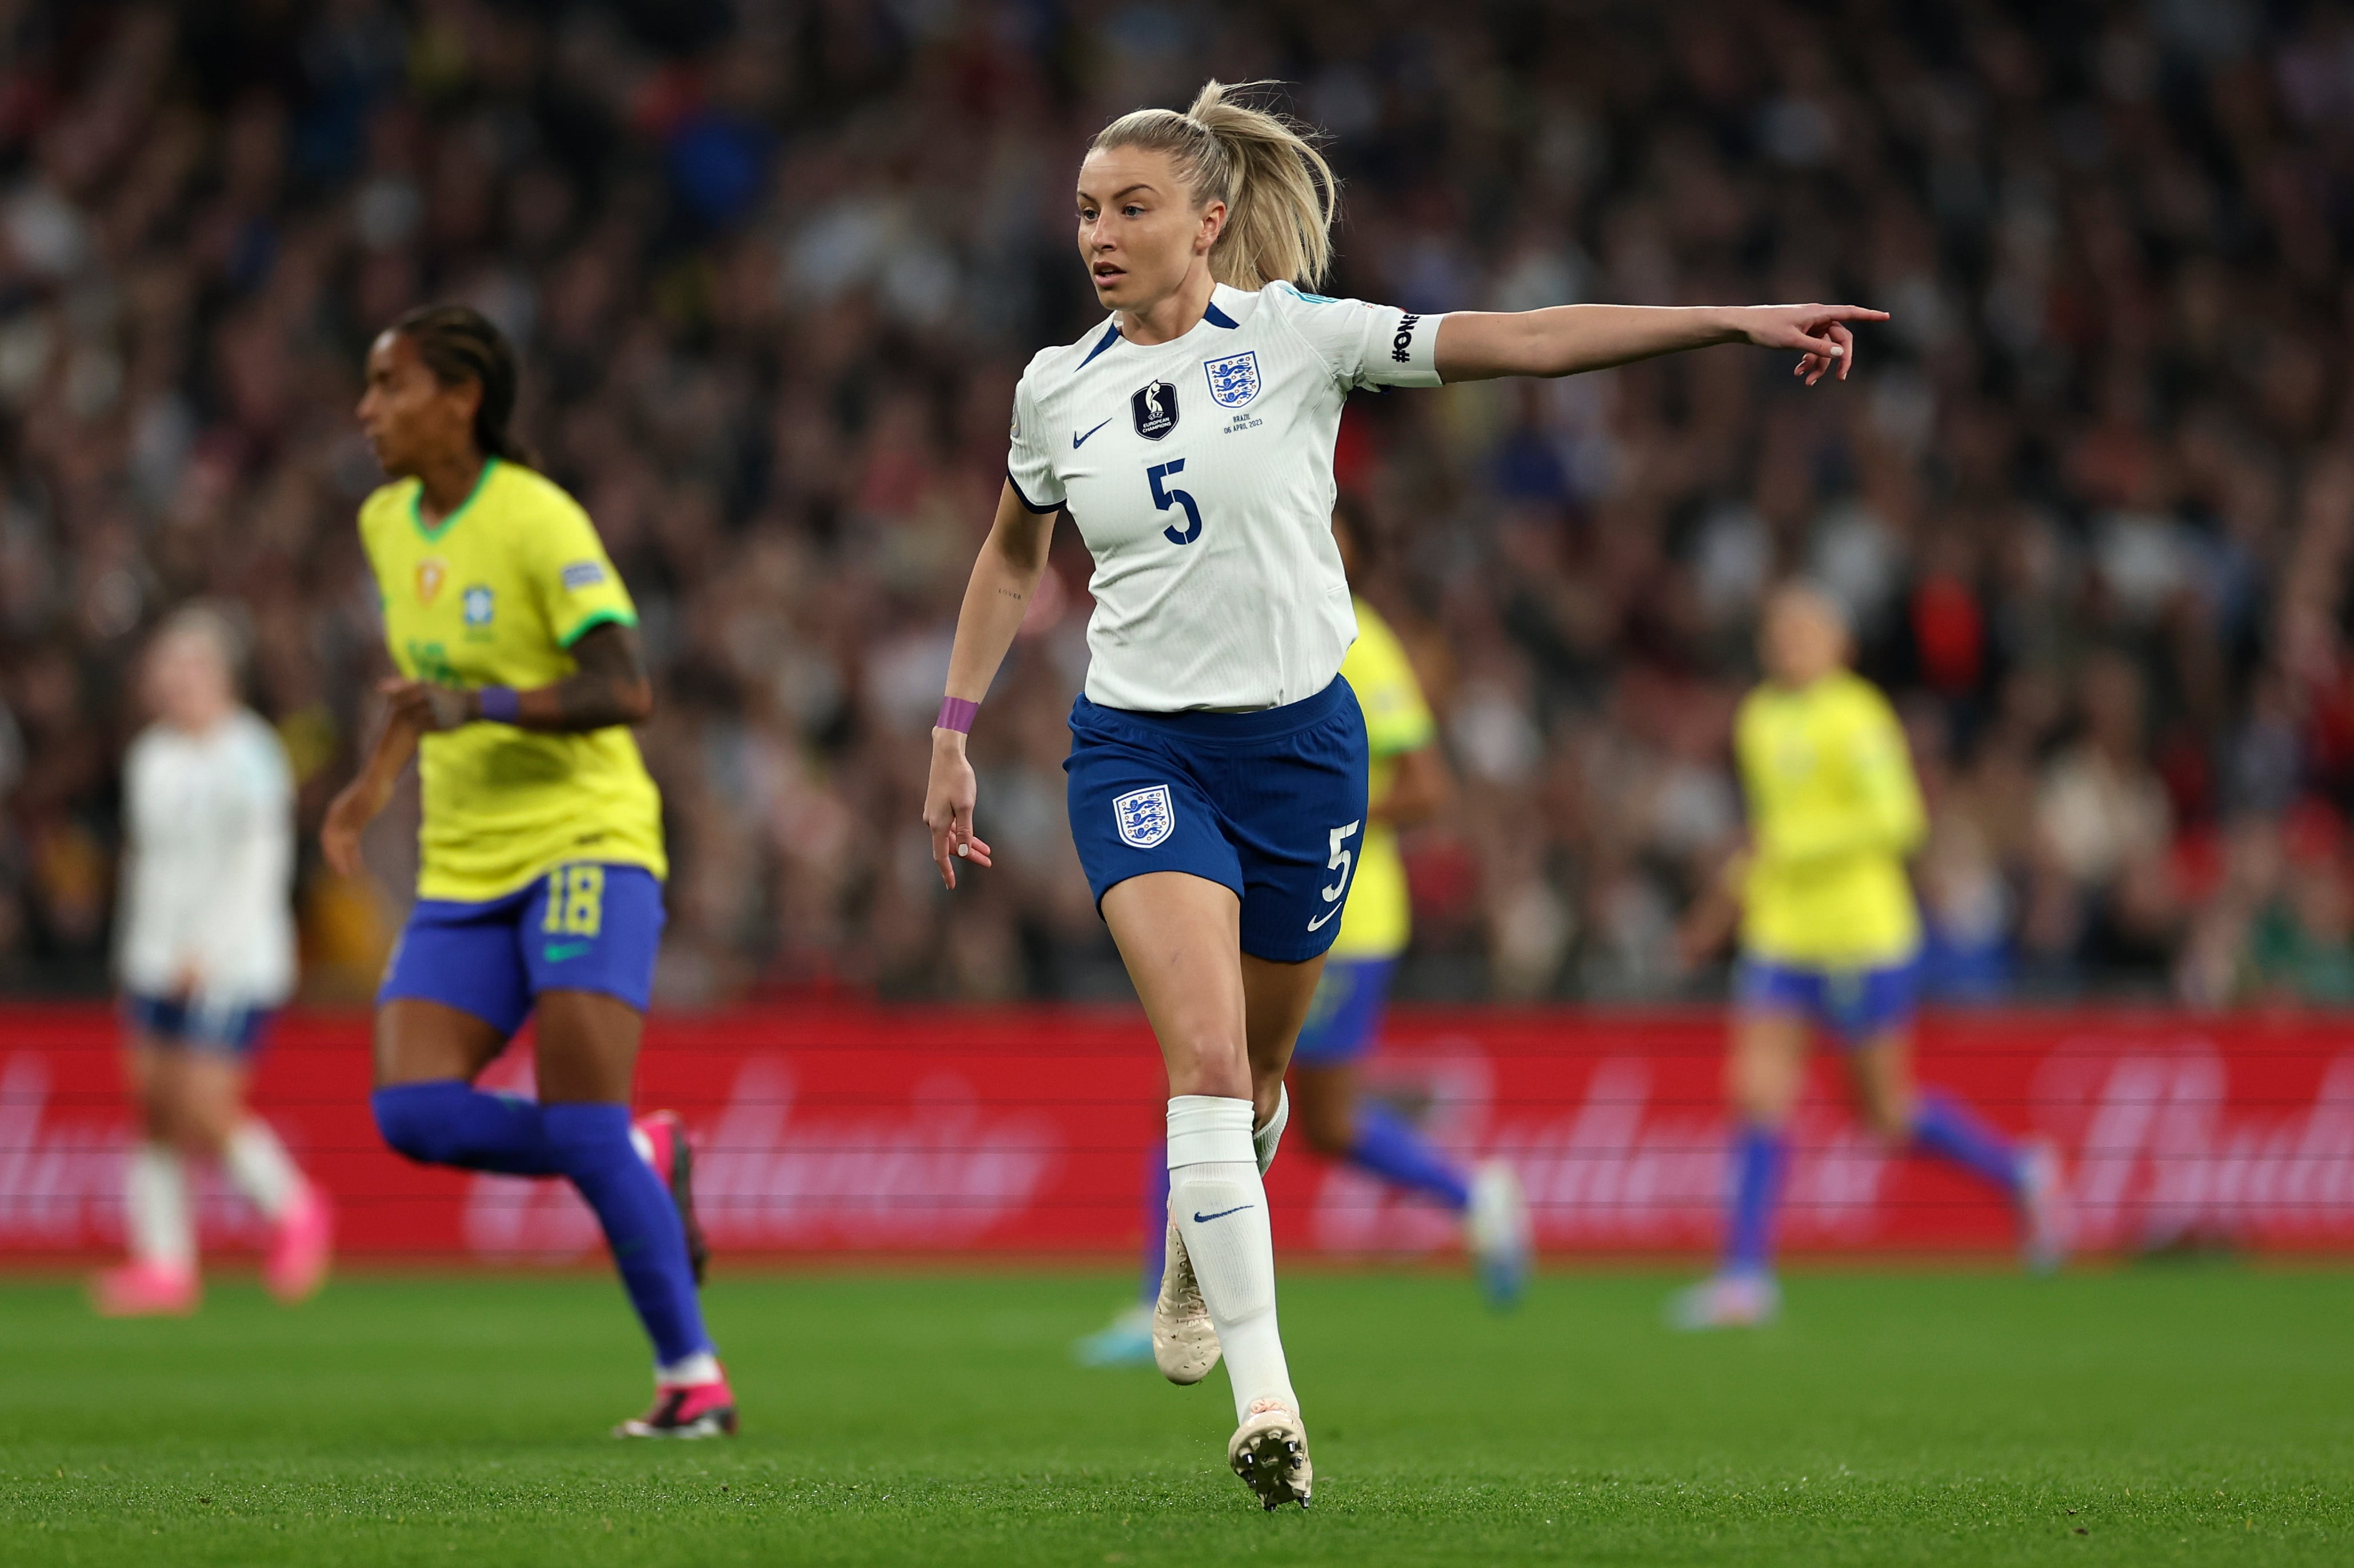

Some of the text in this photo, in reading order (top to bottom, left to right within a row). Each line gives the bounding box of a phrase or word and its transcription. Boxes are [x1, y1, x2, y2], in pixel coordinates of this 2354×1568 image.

[1142, 417, 1170, 428] EUROPEAN
[1233, 414, 1250, 423] BRAZIL
[1233, 423, 1248, 431] APRIL
[1249, 418, 1262, 427] 2023
[1142, 422, 1172, 433] CHAMPIONS
[1146, 458, 1202, 545] 5
[1322, 819, 1360, 902] 5
[541, 867, 605, 938] 18
